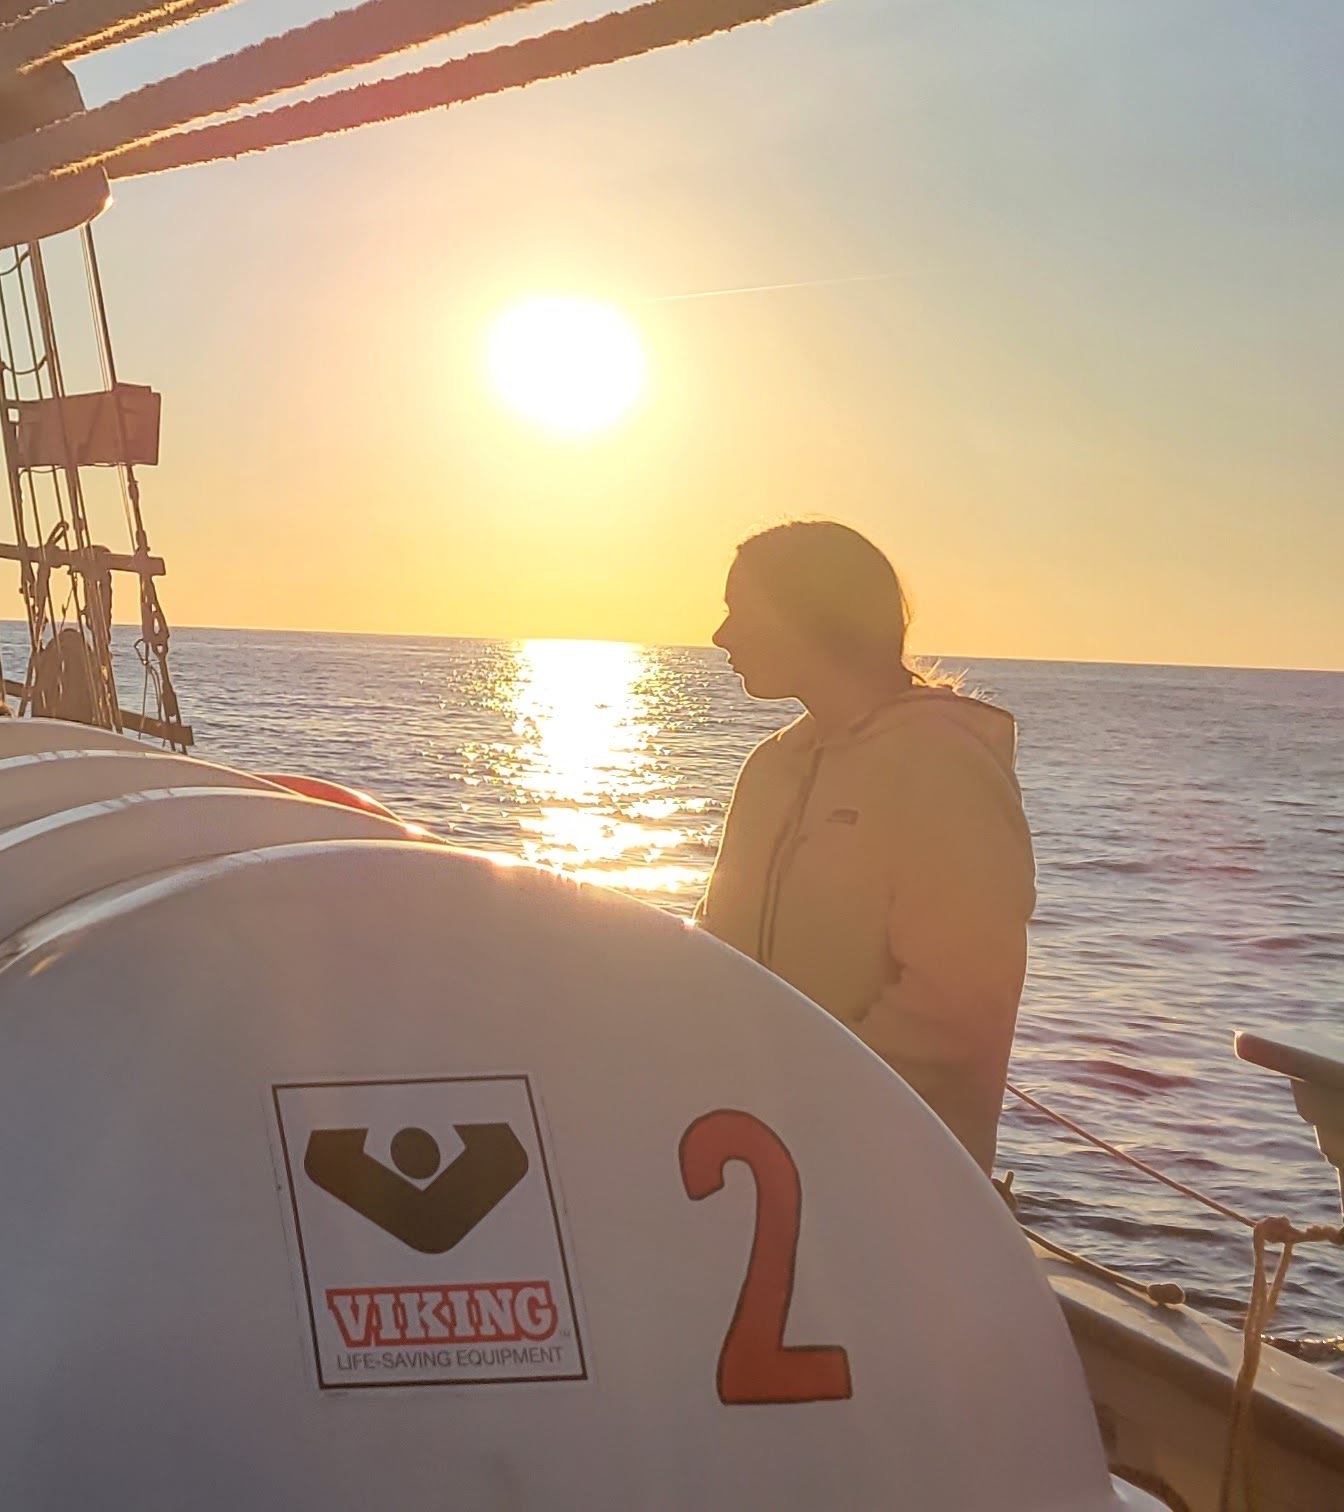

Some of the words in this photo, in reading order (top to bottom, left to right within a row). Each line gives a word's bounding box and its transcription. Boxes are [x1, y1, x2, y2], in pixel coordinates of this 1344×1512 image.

[678, 1108, 853, 1406] 2
[329, 1286, 555, 1342] VIKING
[337, 1349, 451, 1370] LIFE-SAVING
[456, 1345, 563, 1367] EQUIPMENT
